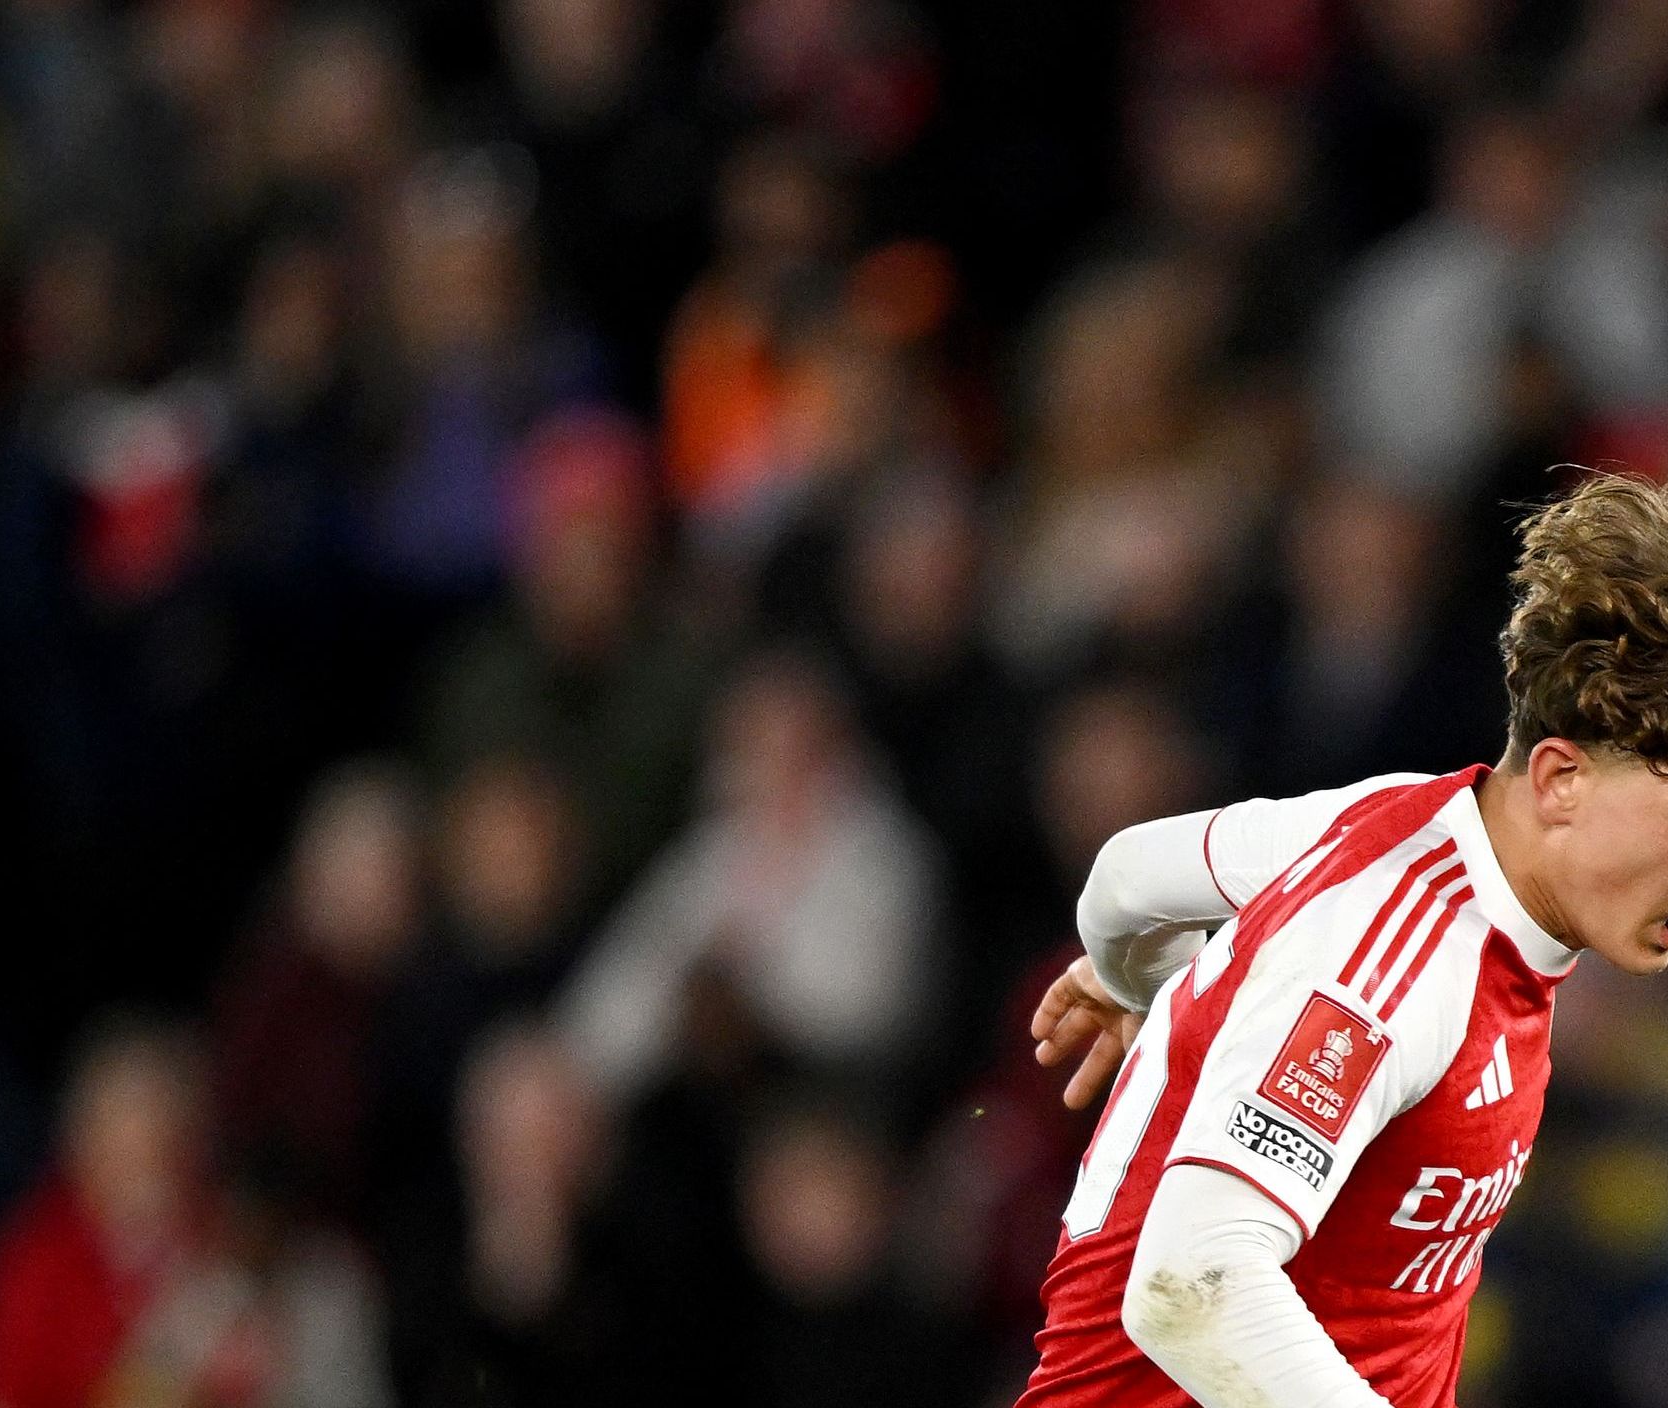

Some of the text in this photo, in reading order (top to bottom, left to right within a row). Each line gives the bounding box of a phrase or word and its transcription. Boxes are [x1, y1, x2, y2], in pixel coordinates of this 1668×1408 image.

[1276, 1076, 1340, 1120] FA CUP
[1285, 1060, 1346, 1109] Emirates
[1230, 1103, 1326, 1170] No room
[1256, 1136, 1326, 1190] racism
